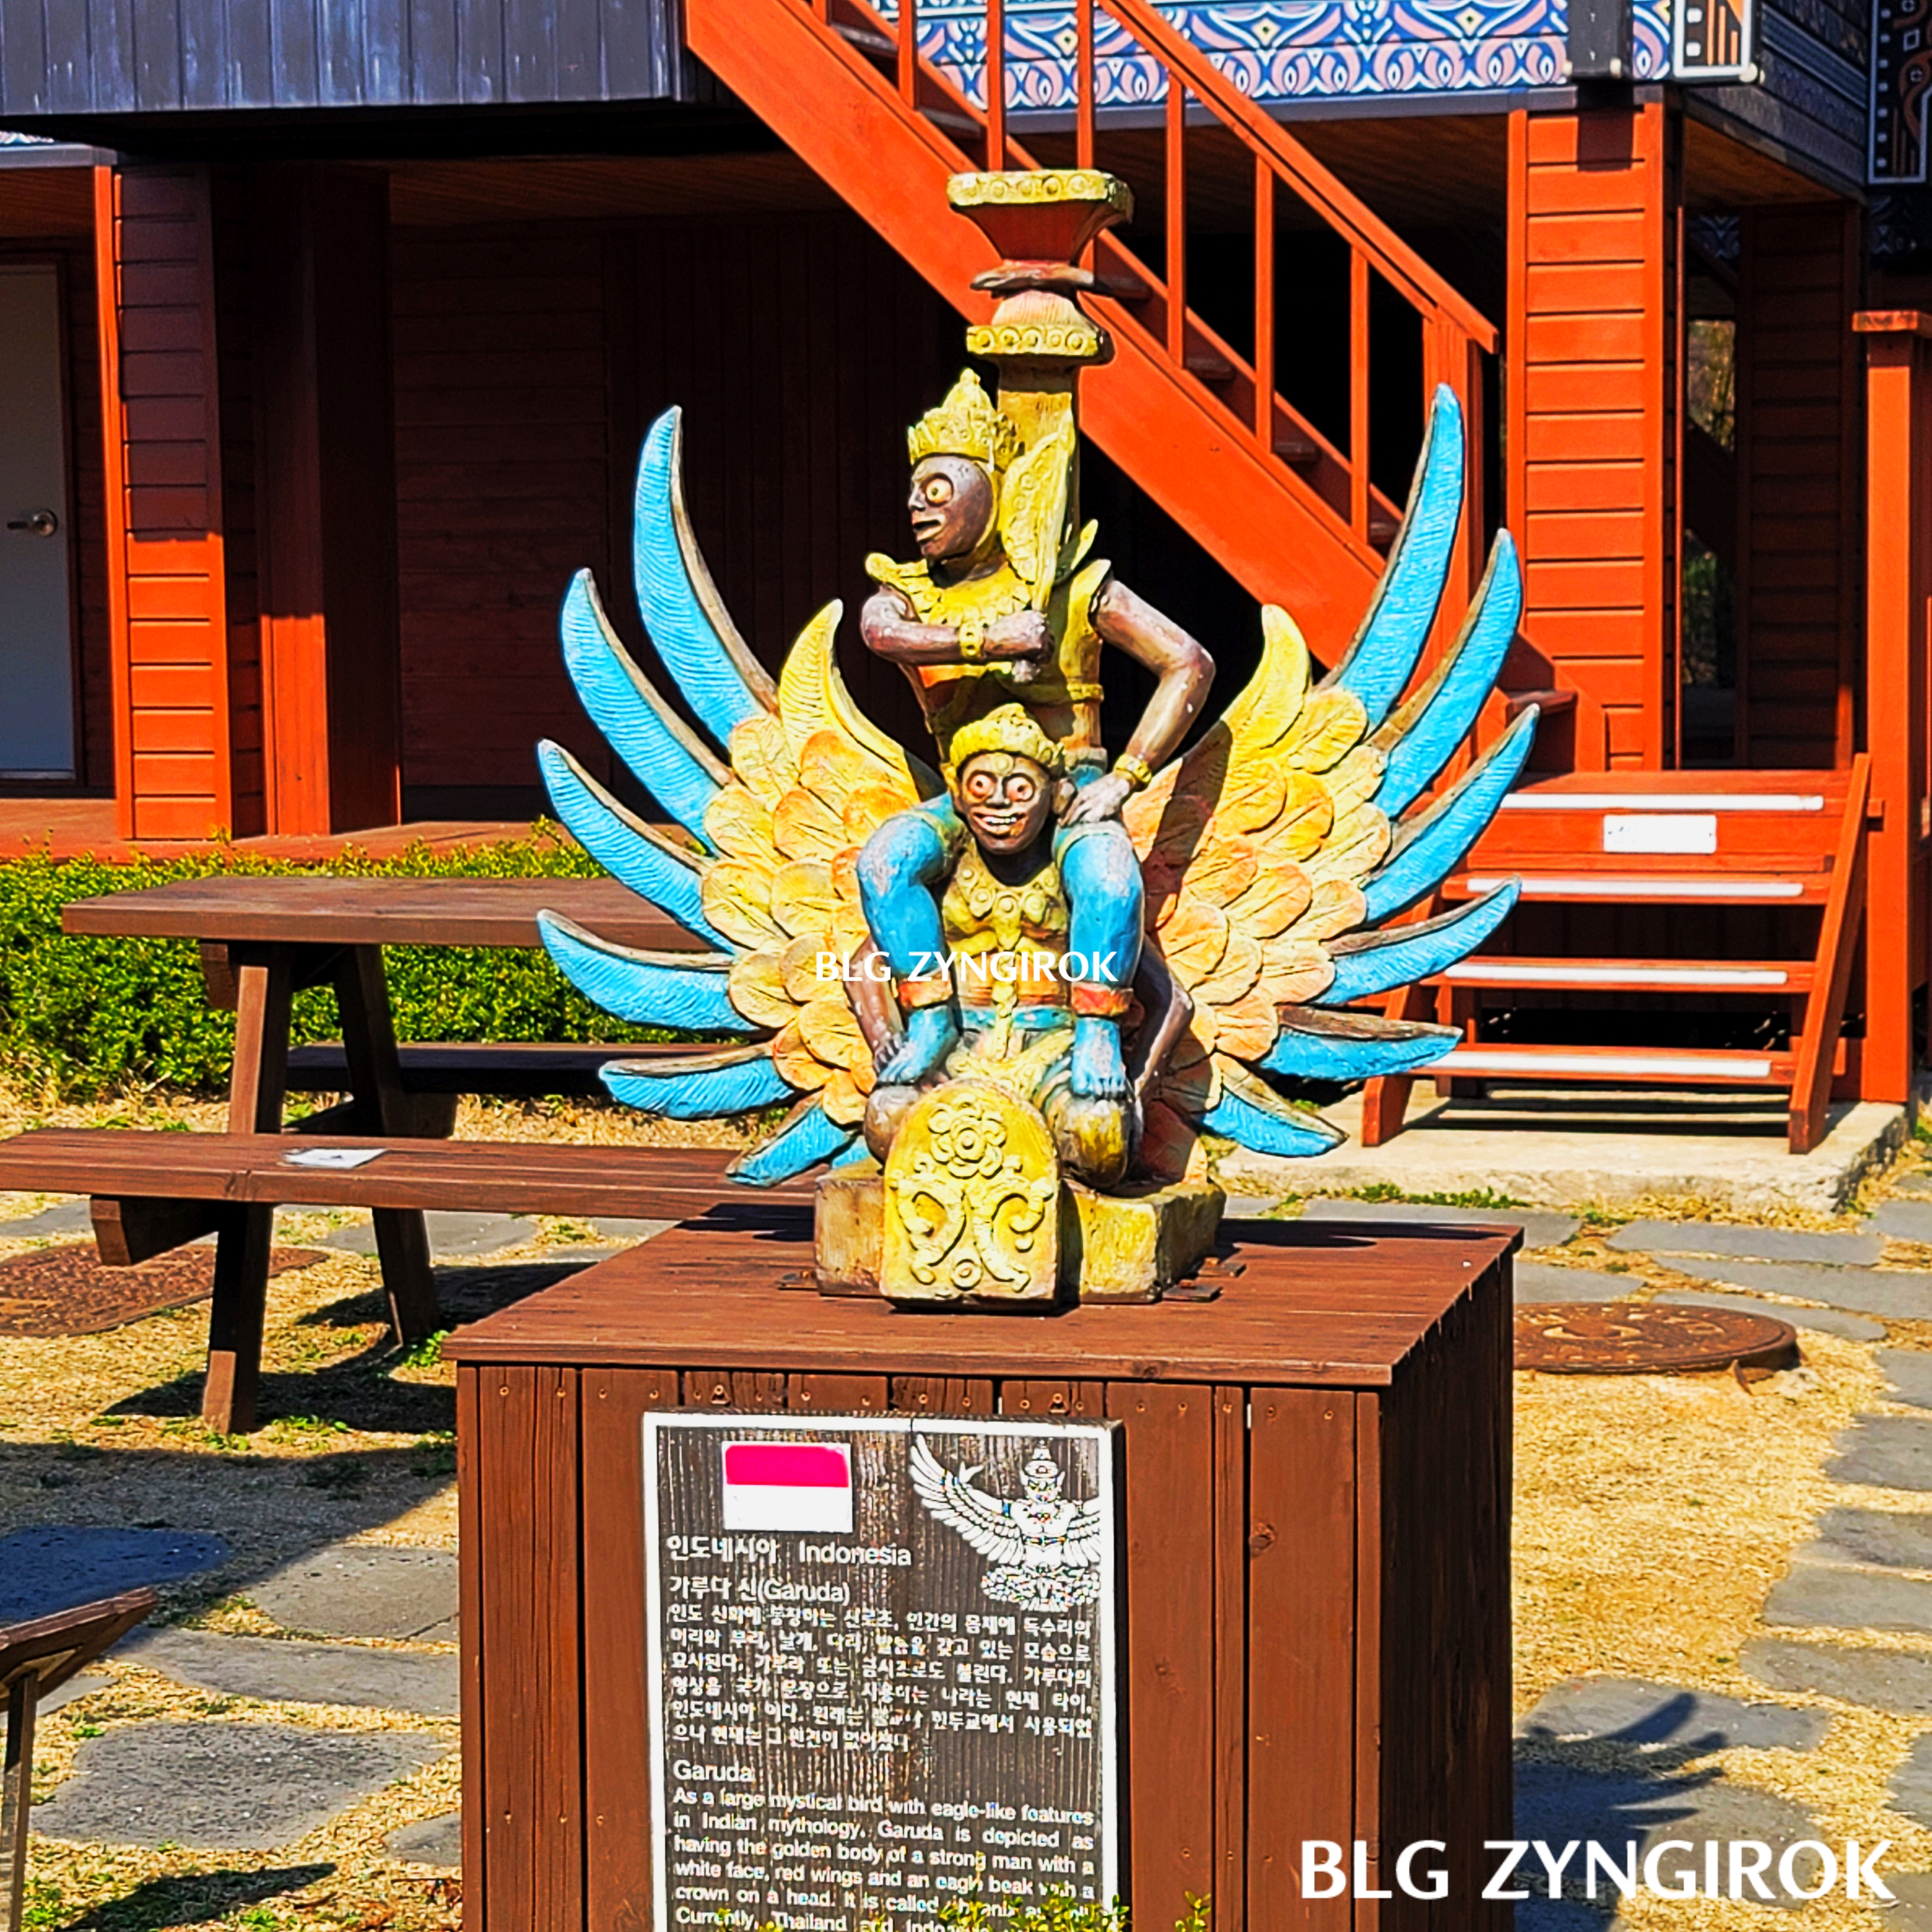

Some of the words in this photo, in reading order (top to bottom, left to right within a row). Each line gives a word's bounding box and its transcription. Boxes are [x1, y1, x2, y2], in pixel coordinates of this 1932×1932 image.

[666, 1535, 777, 1563] 인도네시아
[799, 1539, 912, 1565] Indonesia
[670, 1576, 732, 1599] 가루다
[737, 1578, 850, 1606] 신(Garuda)
[670, 1604, 703, 1622] 인도
[907, 1612, 956, 1632] 인간의
[1023, 1618, 1091, 1639] 독수리의
[671, 1629, 721, 1647] 머리와
[980, 1639, 1013, 1660] 있는
[1024, 1642, 1091, 1663] 모습으로
[1023, 1666, 1091, 1688] 가루다의
[942, 1686, 992, 1709] 나라는
[673, 1759, 754, 1782] Garuda
[673, 1787, 697, 1805] As
[703, 1791, 714, 1804] a
[720, 1787, 765, 1810] large
[768, 1792, 842, 1813] mystical
[848, 1794, 883, 1812] bird
[888, 1798, 925, 1814] with
[931, 1800, 1016, 1821] eagle-like
[1022, 1804, 1094, 1825] features
[674, 1811, 690, 1828] in
[703, 1813, 757, 1831] Indian
[878, 1820, 943, 1841] Garuda
[956, 1825, 971, 1842] is
[982, 1827, 1059, 1848] depicted
[1072, 1835, 1094, 1850] as
[674, 1835, 731, 1856] having
[737, 1837, 766, 1855] the
[772, 1839, 832, 1859] golden
[837, 1842, 883, 1865] body
[911, 1849, 923, 1864] a
[929, 1849, 987, 1871] strong
[992, 1855, 1032, 1870] man
[1038, 1856, 1076, 1873] with
[1082, 1860, 1094, 1875] a
[675, 1860, 721, 1878] white
[775, 1865, 805, 1881] red
[811, 1867, 863, 1887] wings
[868, 1871, 901, 1886] and
[907, 1875, 929, 1888] an
[989, 1876, 1033, 1895] beak
[1082, 1885, 1094, 1899] a
[675, 1887, 729, 1902] crown
[737, 1889, 760, 1904] on
[767, 1889, 778, 1904] a
[886, 1895, 939, 1913] called
